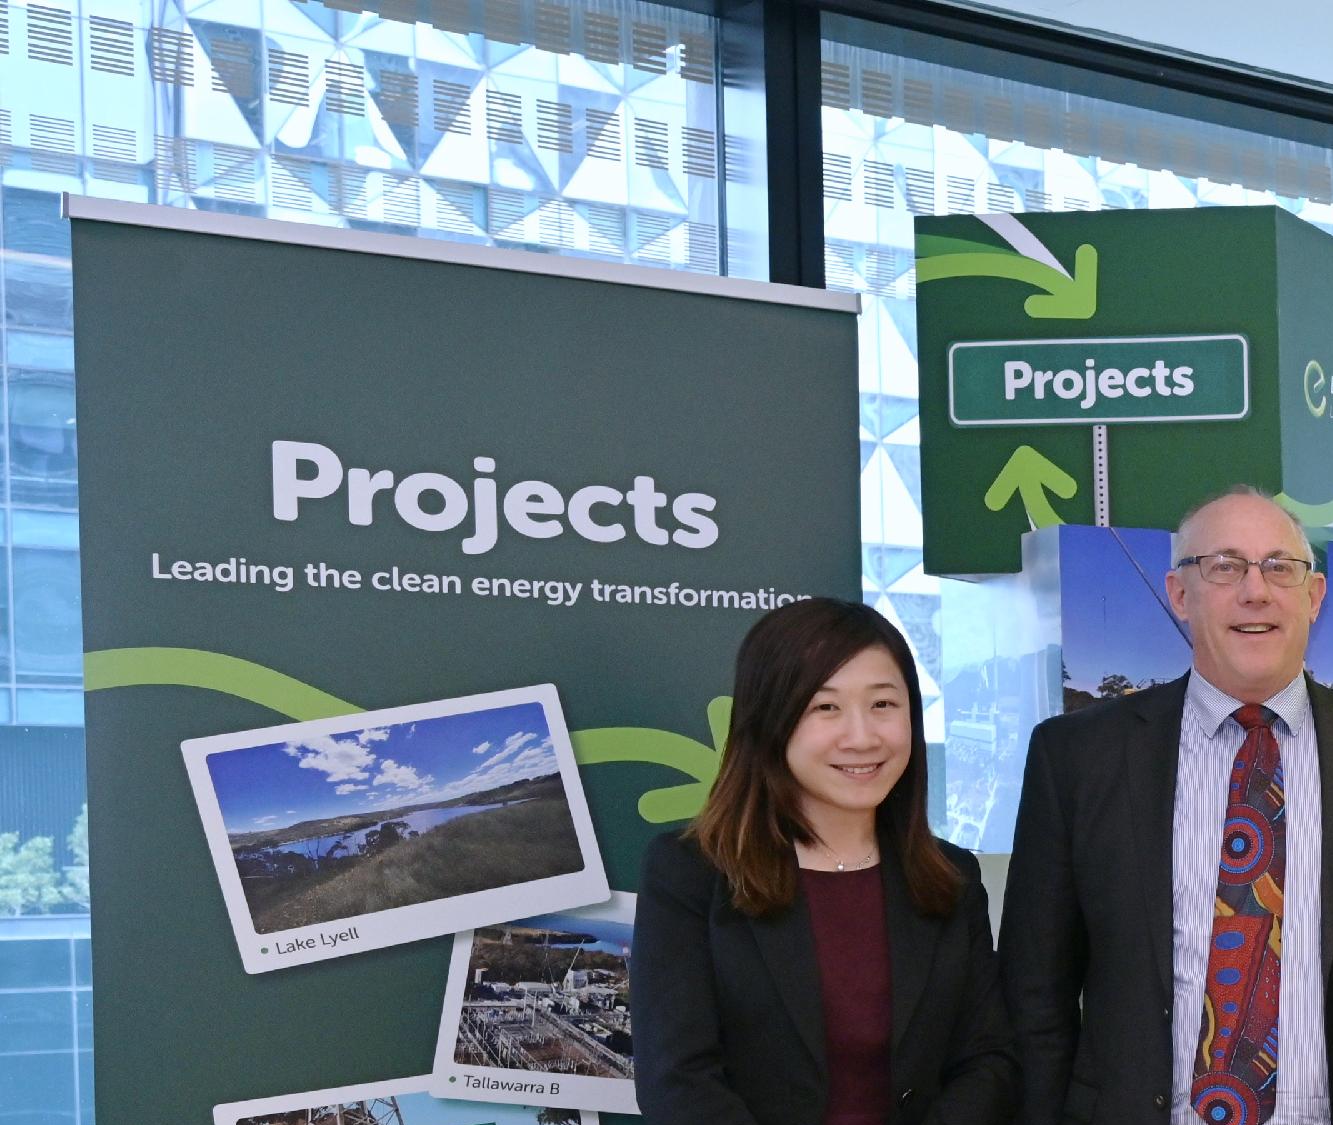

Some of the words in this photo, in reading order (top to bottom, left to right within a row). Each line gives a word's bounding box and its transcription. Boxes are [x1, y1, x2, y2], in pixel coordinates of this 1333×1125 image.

[1004, 359, 1194, 409] Projects
[271, 440, 720, 555] Projects
[152, 553, 294, 593] Leading
[304, 563, 362, 590] the
[371, 566, 462, 595] clean
[471, 576, 583, 606] energy
[276, 936, 316, 955] Lake
[321, 927, 360, 948] Lyell
[463, 1074, 545, 1095] Tallawarra
[550, 1082, 561, 1096] B
